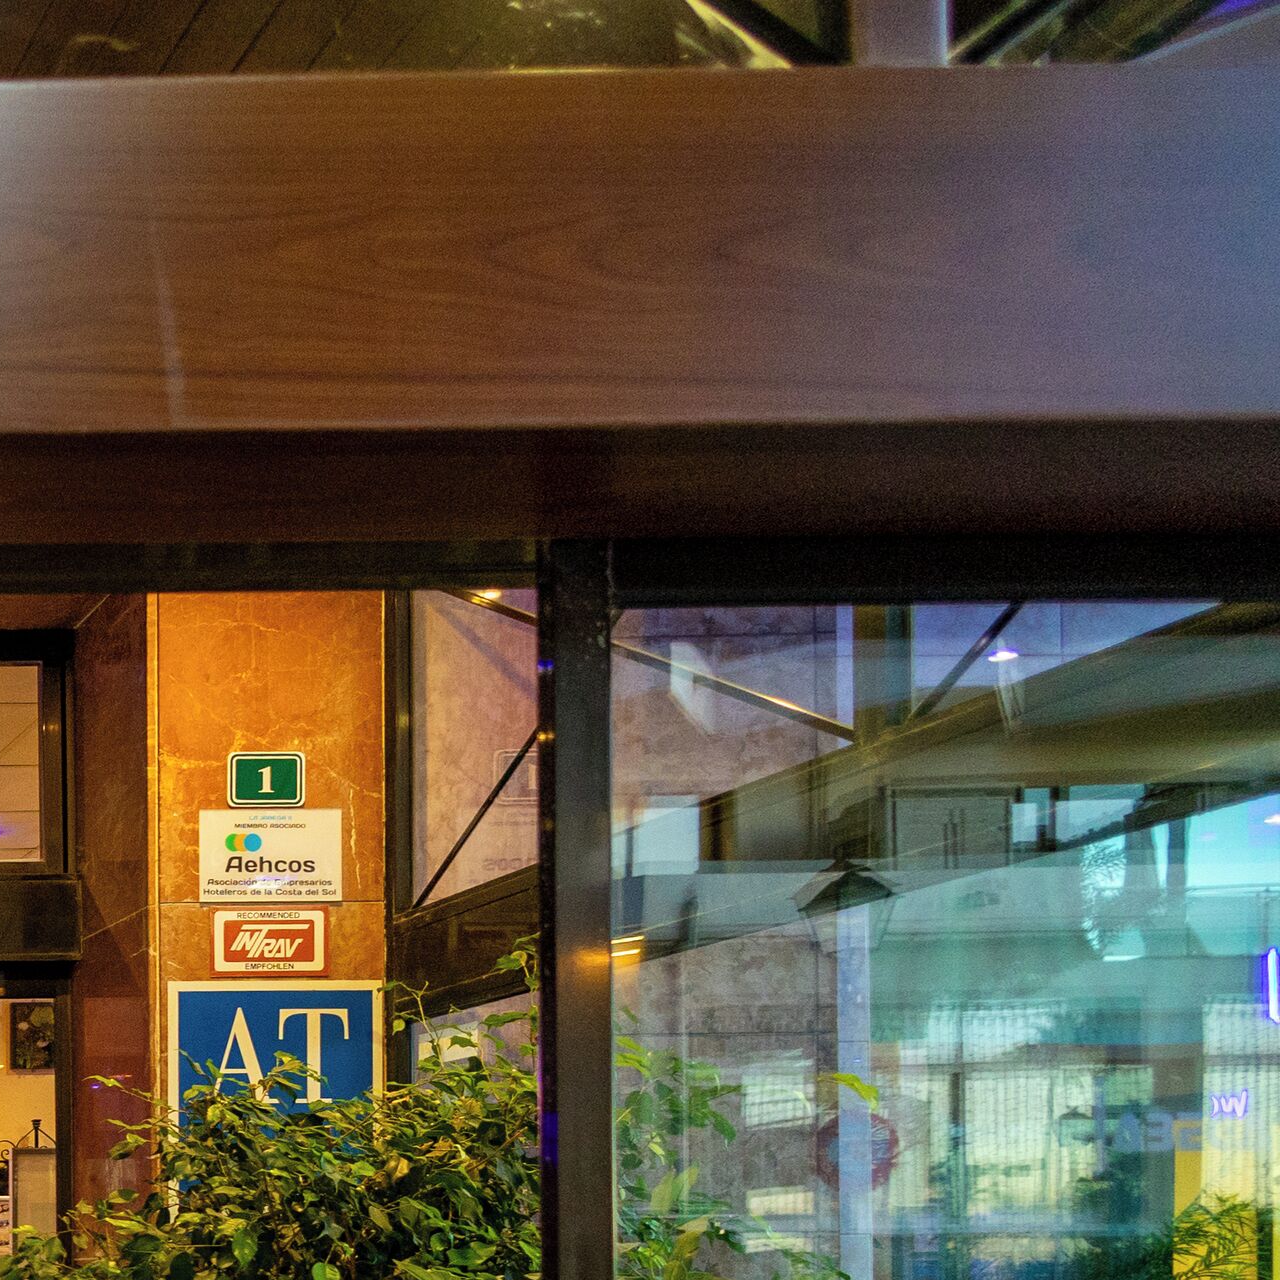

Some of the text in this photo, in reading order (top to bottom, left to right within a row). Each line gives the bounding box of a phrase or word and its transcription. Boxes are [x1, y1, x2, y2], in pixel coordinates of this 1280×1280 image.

[257, 765, 276, 794] 1
[224, 856, 316, 873] Aehcos
[203, 888, 337, 896] Hoteleros de la Costa del Sol
[207, 877, 258, 886] Asociación
[230, 924, 311, 958] INTRAV
[213, 1007, 350, 1104] AT
